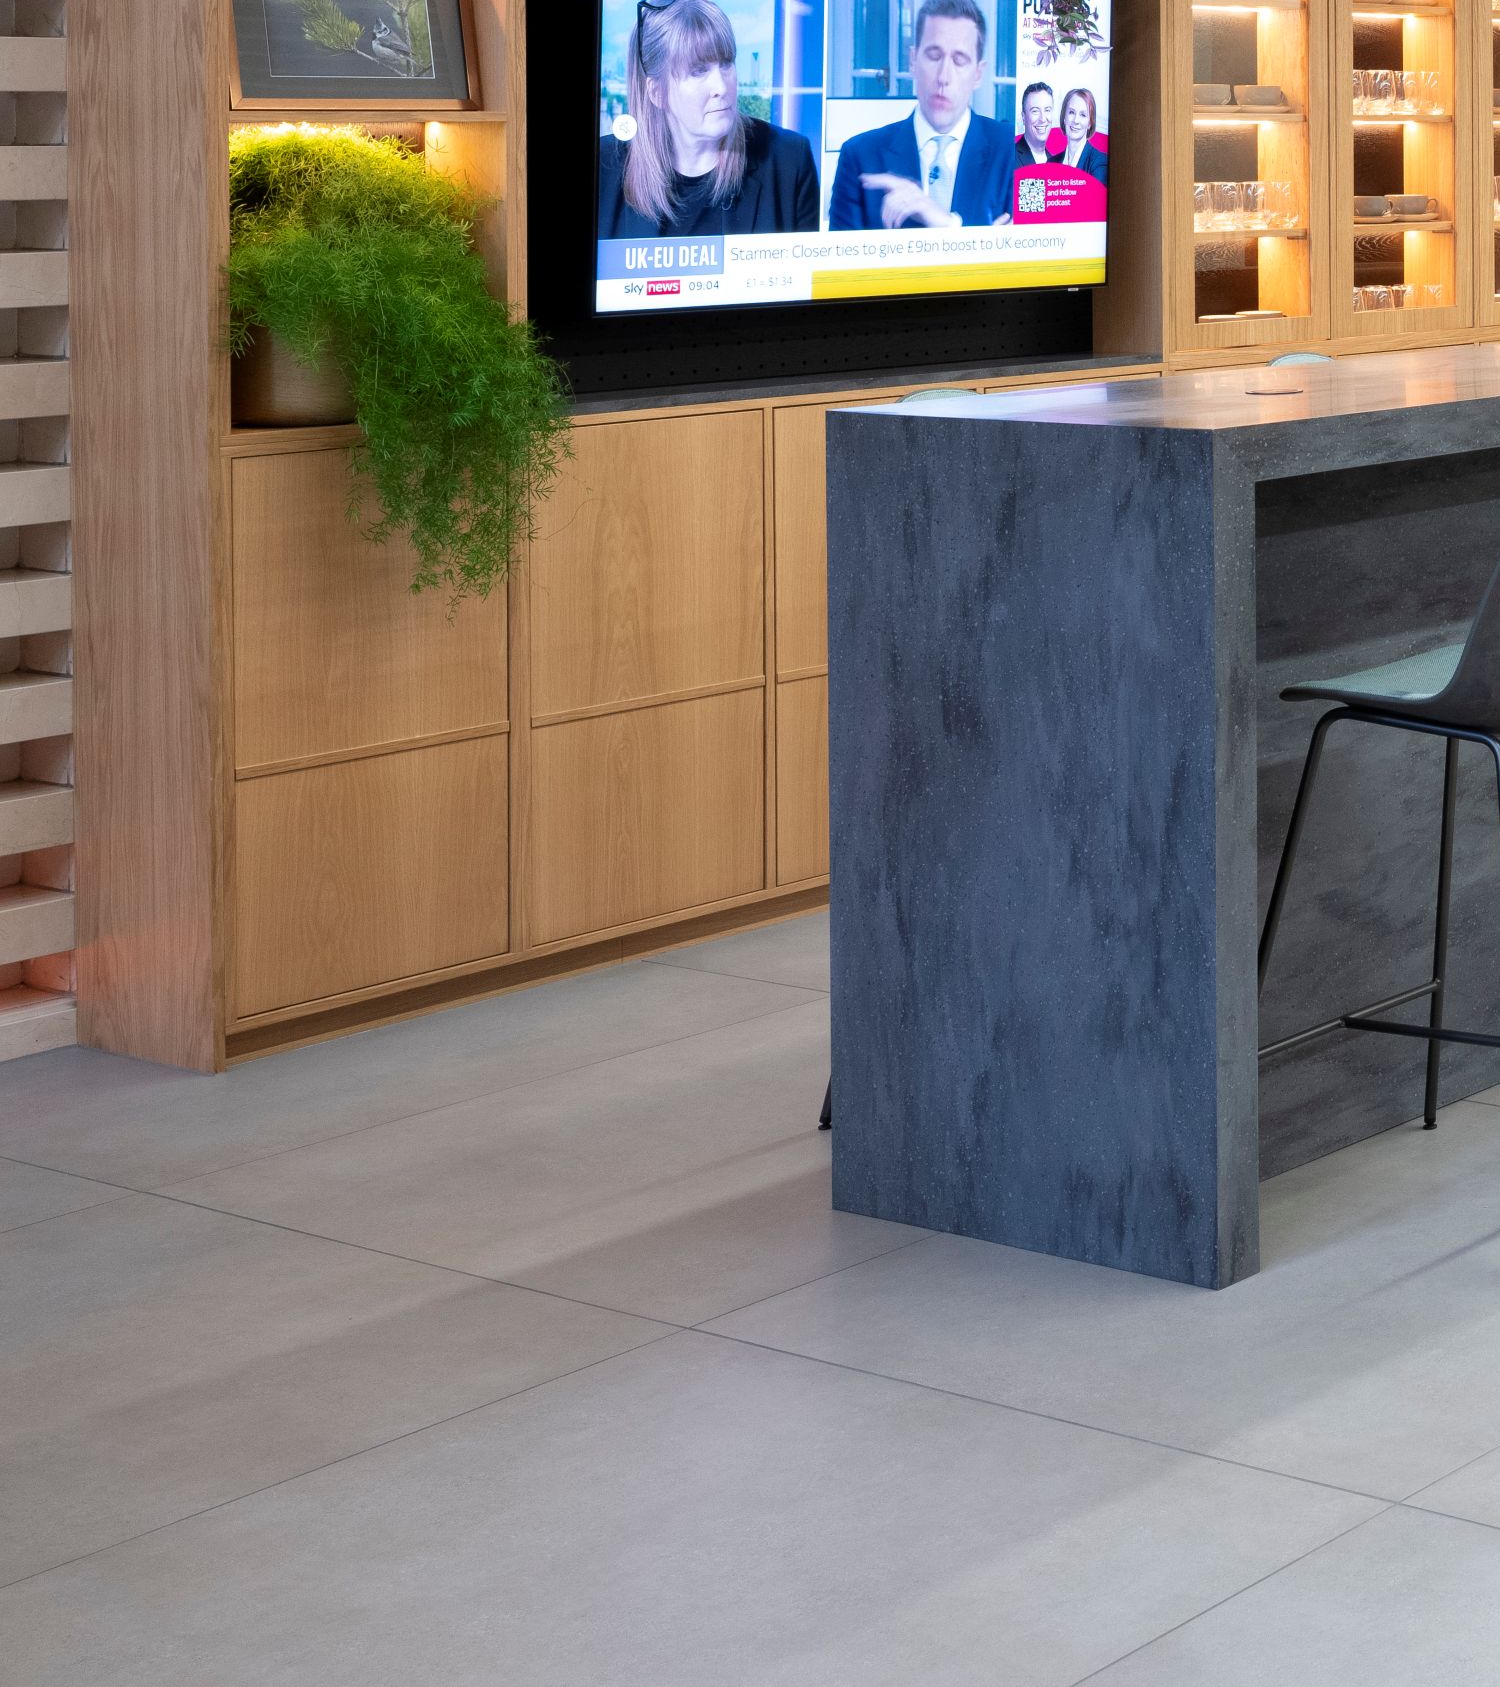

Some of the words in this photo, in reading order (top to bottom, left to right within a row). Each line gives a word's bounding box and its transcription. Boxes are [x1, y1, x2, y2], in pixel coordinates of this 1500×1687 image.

[1070, 178, 1086, 186] listen
[1059, 188, 1077, 196] follow
[1046, 199, 1071, 208] podcast
[730, 247, 788, 261] Starmer:
[792, 243, 832, 258] Closer
[836, 243, 860, 256] ties
[863, 242, 877, 255] to
[879, 241, 904, 258] give
[907, 239, 940, 254] £9bn
[942, 238, 977, 252] boost
[980, 238, 993, 250] to
[995, 236, 1012, 250] UK
[1014, 237, 1067, 250] economy
[625, 247, 674, 270] UK-EU
[678, 244, 718, 268] DEAL
[624, 280, 644, 296] sky
[647, 281, 680, 295] news
[688, 281, 719, 292] 09:04
